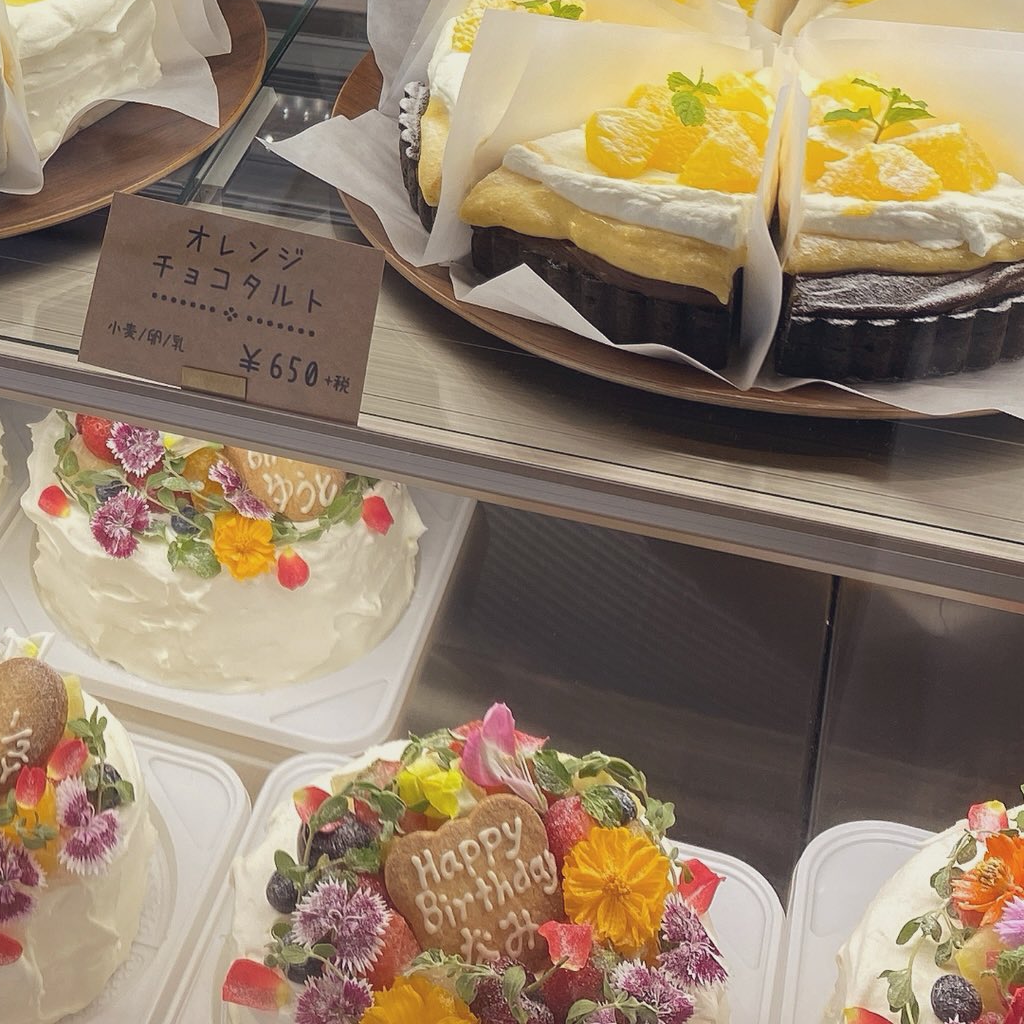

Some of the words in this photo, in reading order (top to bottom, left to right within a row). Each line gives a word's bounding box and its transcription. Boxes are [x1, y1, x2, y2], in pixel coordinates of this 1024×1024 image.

[187, 225, 304, 271] オレンジ
[153, 255, 322, 313] チョコタルト
[108, 320, 185, 352] 小麦/卵/乳
[411, 816, 523, 890] Happy
[415, 848, 559, 935] Birthday
